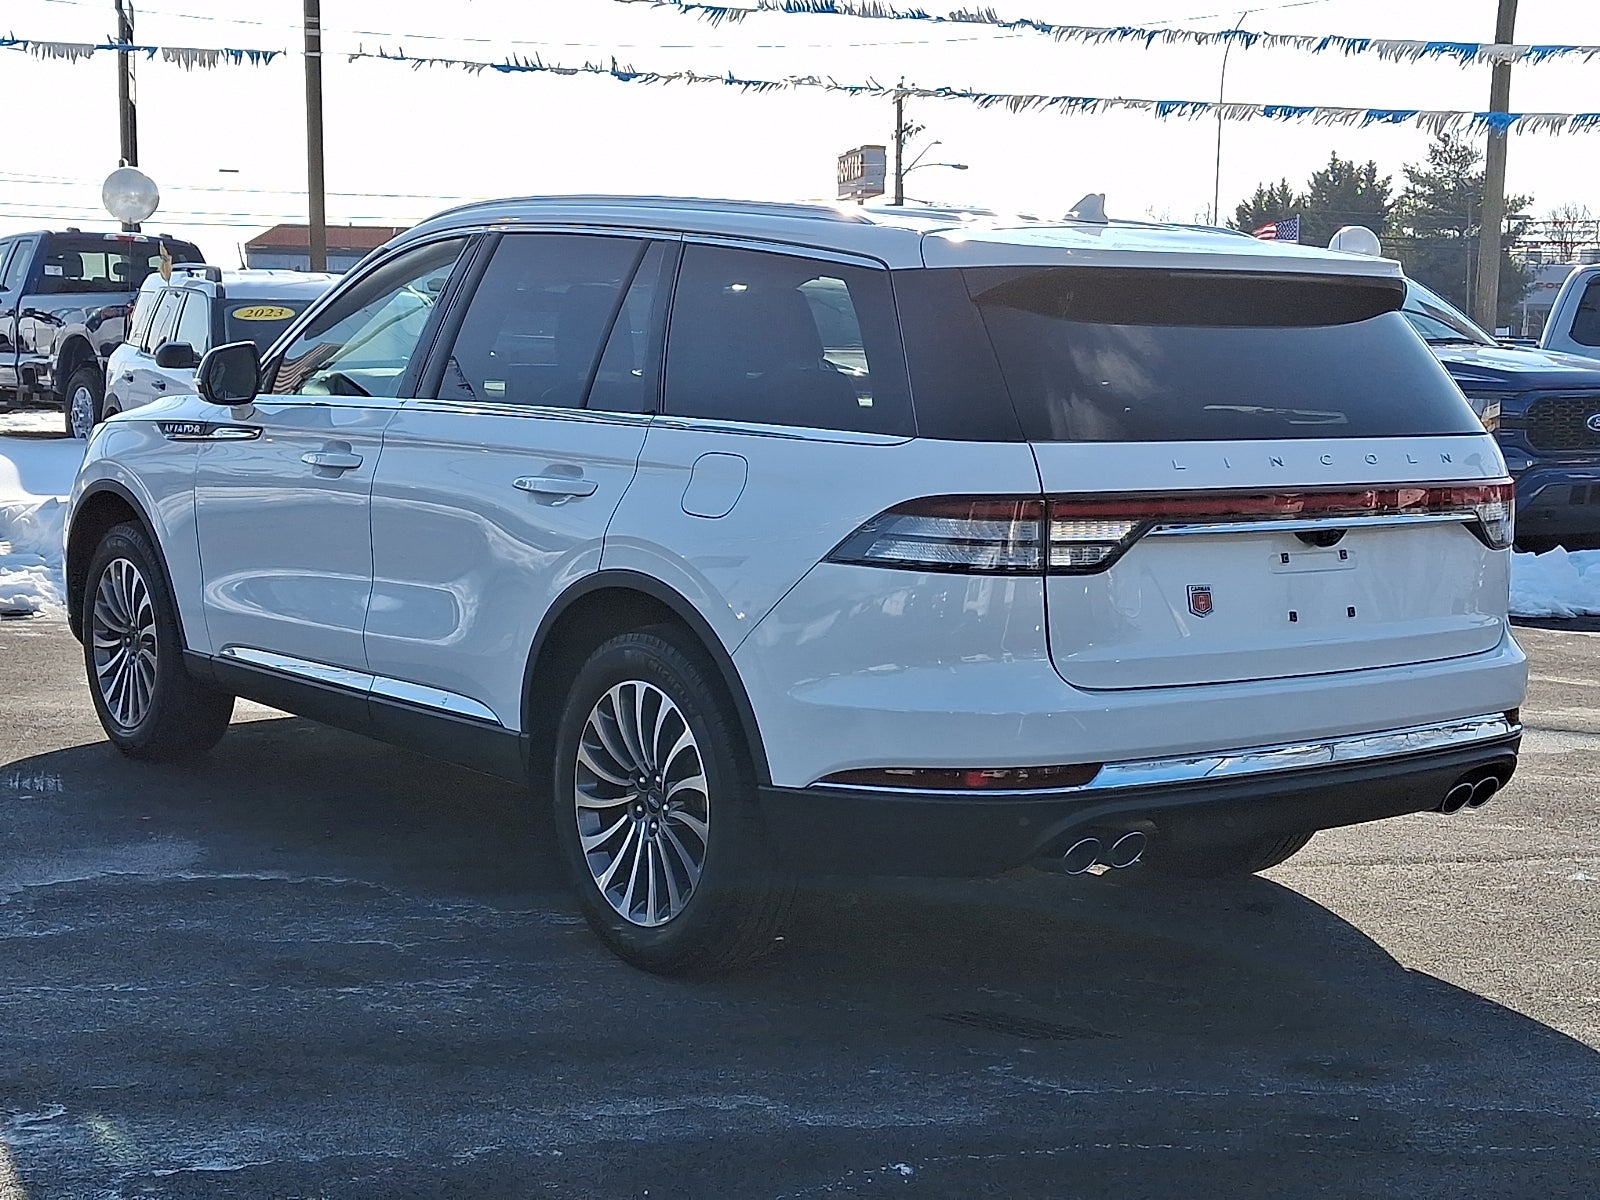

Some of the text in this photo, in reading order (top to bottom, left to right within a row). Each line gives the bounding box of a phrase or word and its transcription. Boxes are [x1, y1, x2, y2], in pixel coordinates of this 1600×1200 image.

[243, 308, 285, 318] 2023
[163, 423, 201, 434] AVIATOR
[1171, 453, 1453, 471] LINCOLN
